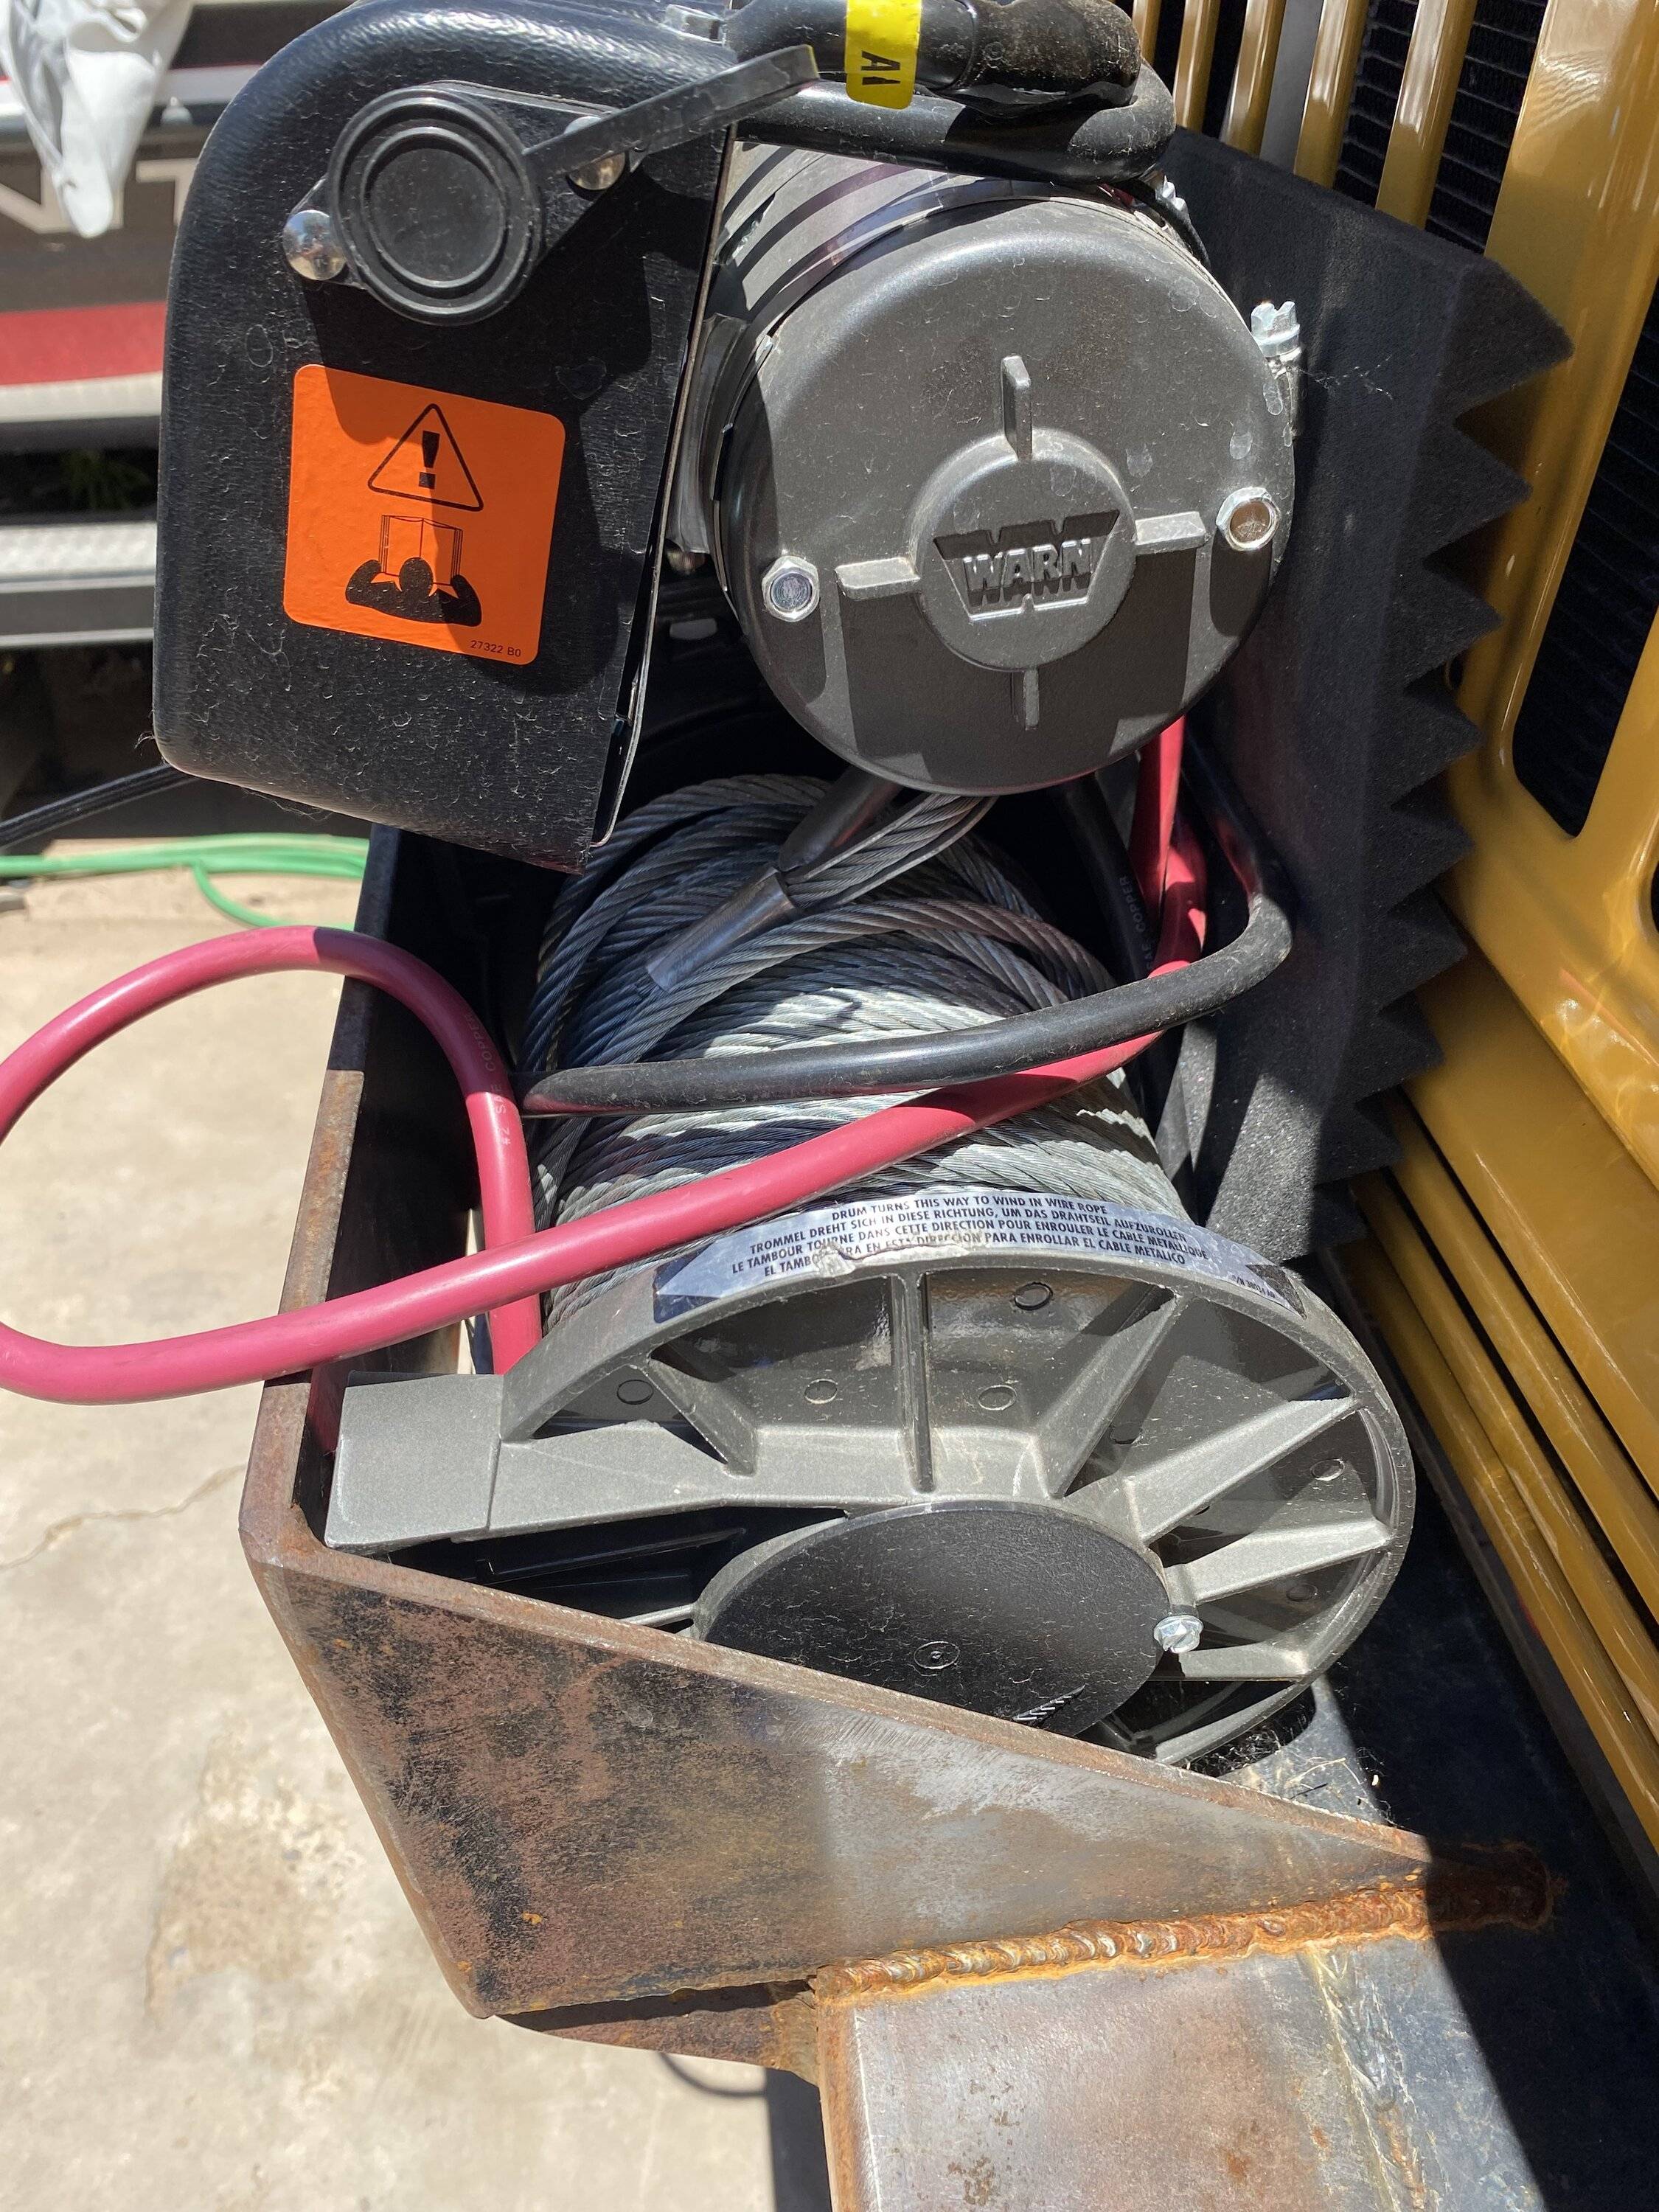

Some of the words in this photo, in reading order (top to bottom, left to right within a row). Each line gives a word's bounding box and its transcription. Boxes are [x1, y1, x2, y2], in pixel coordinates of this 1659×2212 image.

[963, 538, 1093, 594] WARN
[470, 640, 503, 654] 27322
[1119, 876, 1146, 932] COPPER
[466, 1014, 495, 1071] COPPER
[491, 1084, 506, 1114] SAE
[495, 1125, 511, 1146] #2
[832, 1207, 866, 1220] DRUM
[872, 1201, 910, 1213] TURNS
[914, 1198, 939, 1208] THIS
[943, 1197, 969, 1206] WAY
[974, 1196, 989, 1204] TO
[992, 1196, 1026, 1206] WIND
[1029, 1198, 1043, 1206] IN
[1045, 1197, 1075, 1209] WIRE
[1077, 1203, 1107, 1214] ROPE
[732, 1262, 744, 1274] LE
[748, 1245, 803, 1268] TAMBOUR
[859, 1228, 891, 1240] DANS
[895, 1223, 928, 1235] CETTE
[932, 1220, 994, 1231] DIRECTION
[998, 1220, 1032, 1230] POUR
[1035, 1221, 1094, 1236] ENROULER
[1098, 1228, 1110, 1237] LE
[1113, 1229, 1147, 1243] CABLE
[1147, 1235, 1208, 1259] METALLIQUE
[750, 1231, 806, 1253] TROMMEL
[810, 1222, 847, 1238] DREHT
[851, 1217, 877, 1228] SICH
[882, 1214, 894, 1224] IN
[898, 1210, 930, 1222] DIESE
[933, 1208, 998, 1218] RICHTUNG,
[1002, 1208, 1021, 1217] UM
[1024, 1209, 1048, 1219] DAS
[1051, 1210, 1111, 1226] DRAHTSEIL
[1114, 1219, 1186, 1242] AUFZUROLLEN
[764, 1265, 776, 1276] EL
[866, 1242, 880, 1253] EN
[985, 1232, 1017, 1242] PARA
[1020, 1233, 1079, 1246] ENROLLAR
[1083, 1238, 1096, 1248] EL
[1099, 1239, 1132, 1253] CABLE
[1134, 1245, 1186, 1265] METALICO
